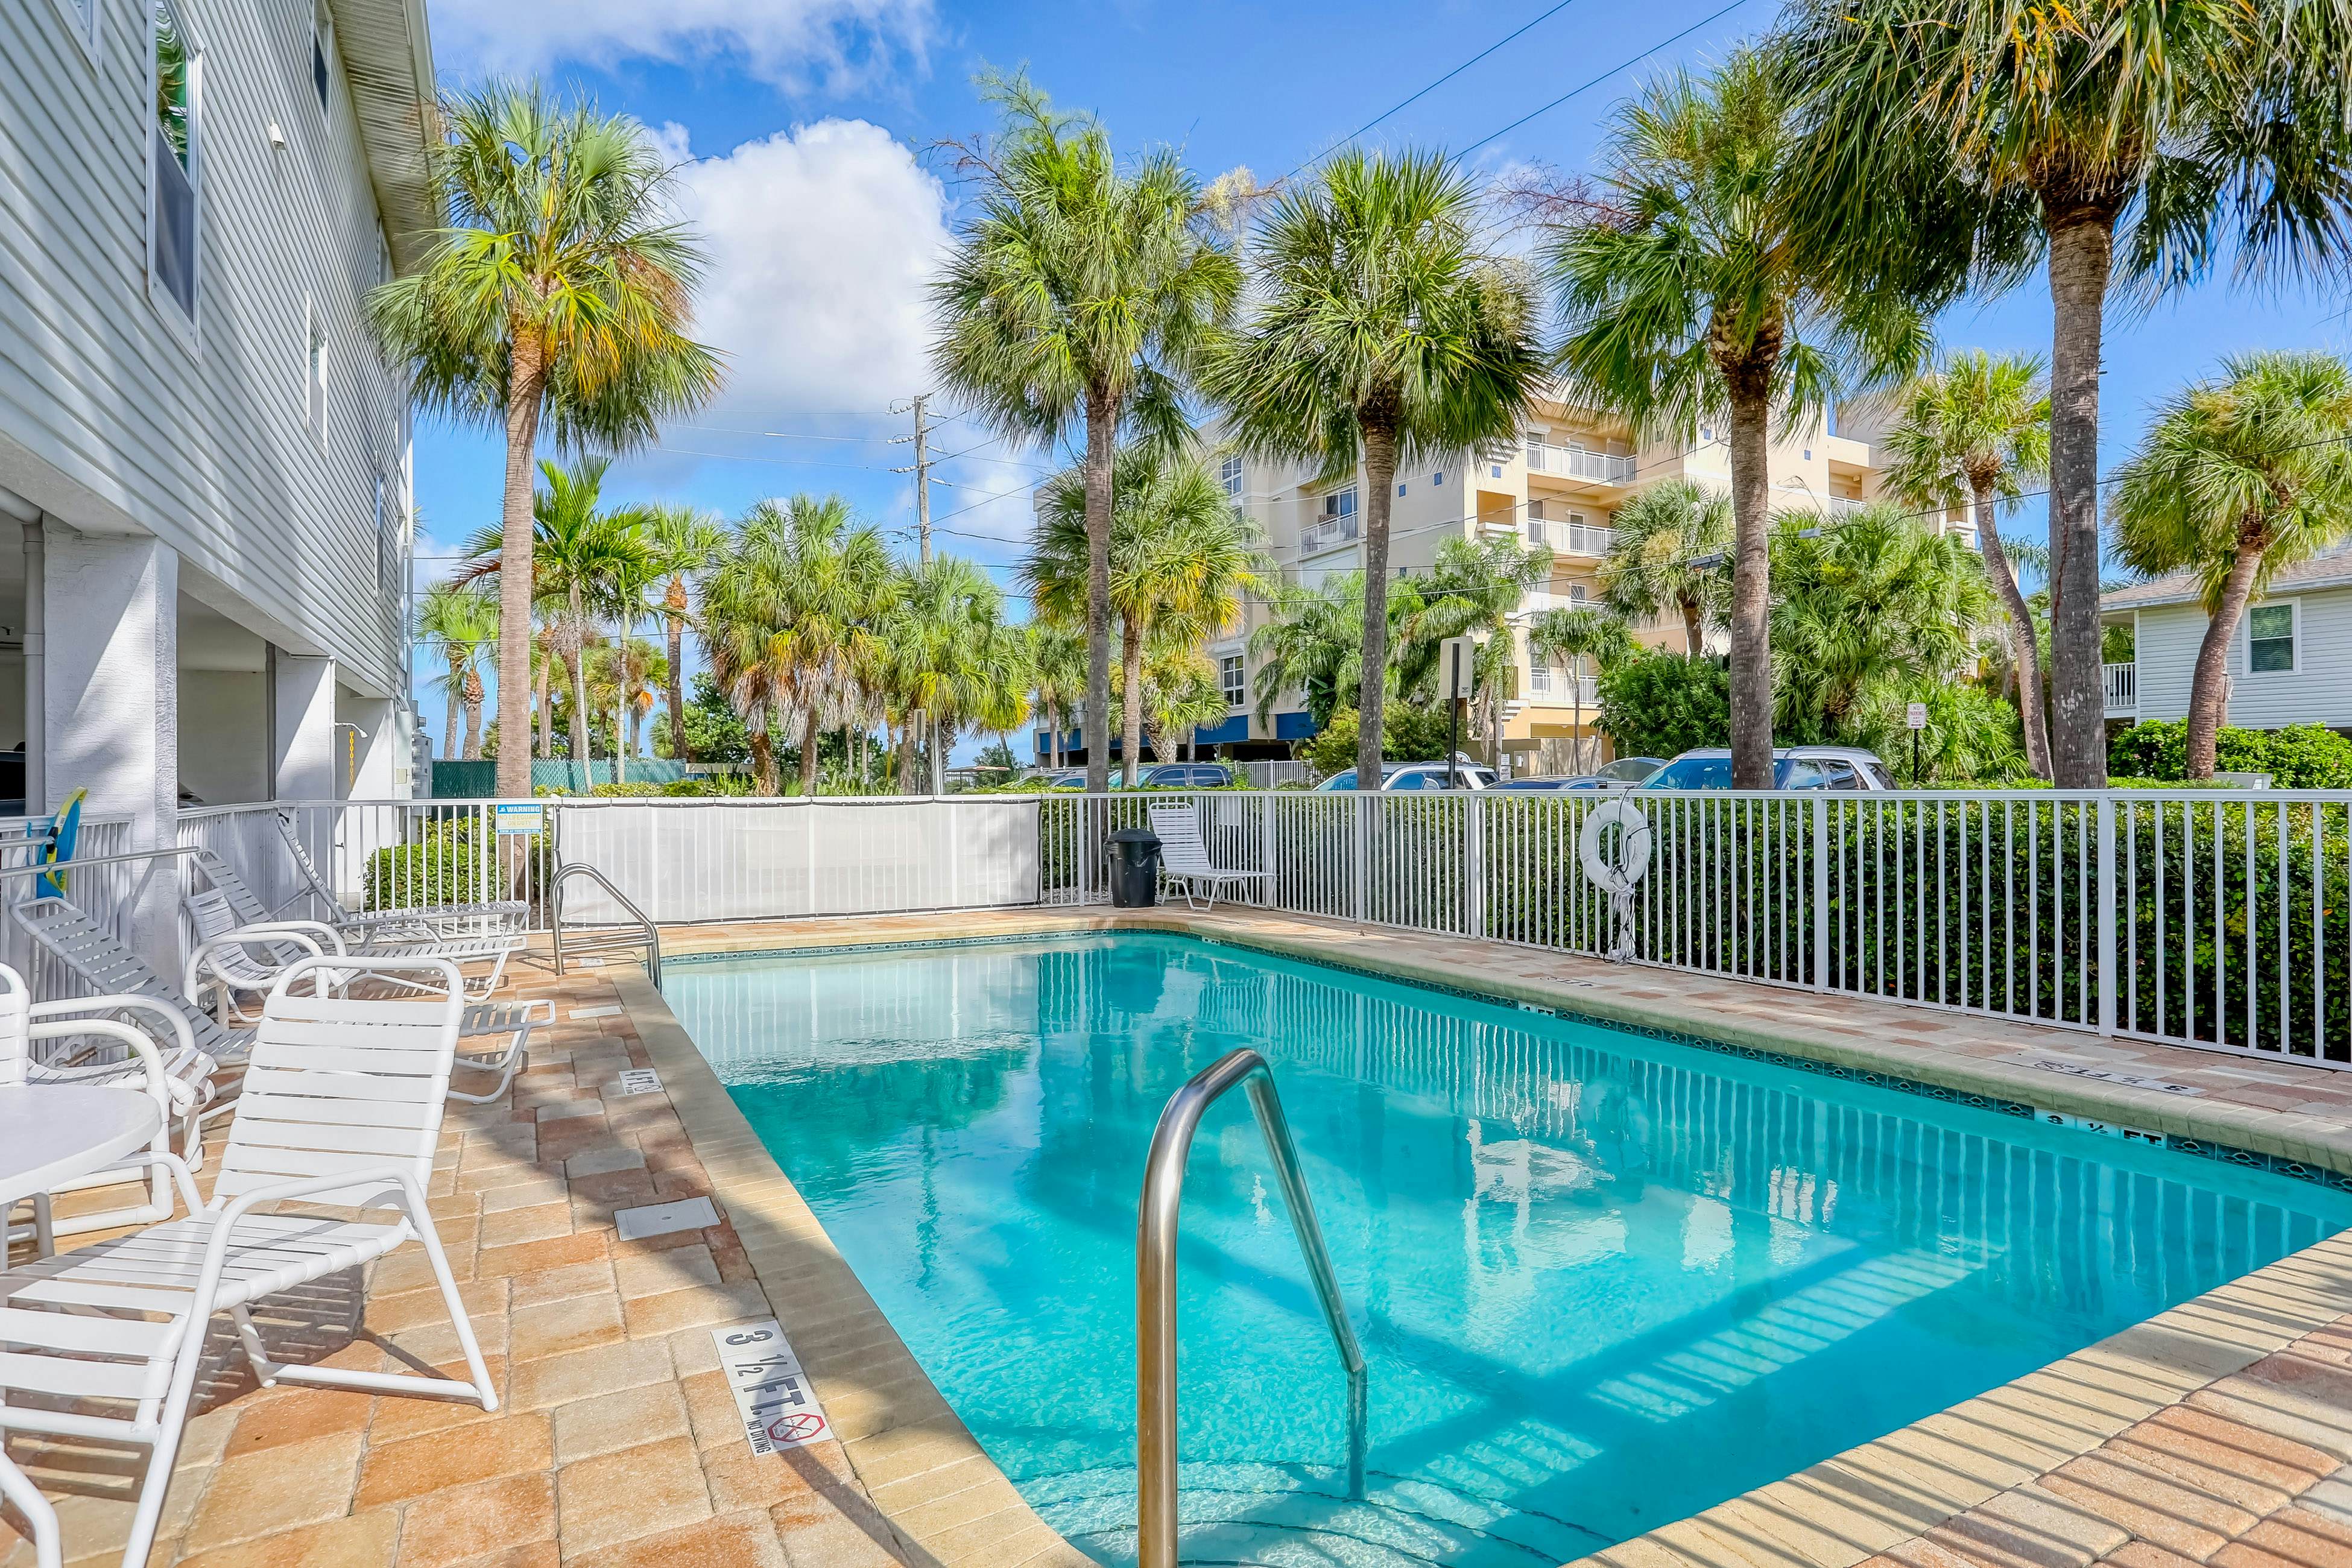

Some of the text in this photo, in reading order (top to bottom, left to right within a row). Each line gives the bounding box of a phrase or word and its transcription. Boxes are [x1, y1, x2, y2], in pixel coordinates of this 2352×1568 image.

[2047, 1115, 2064, 1125] 3
[726, 1330, 773, 1345] 3
[746, 1419, 771, 1453] NO DIVING
